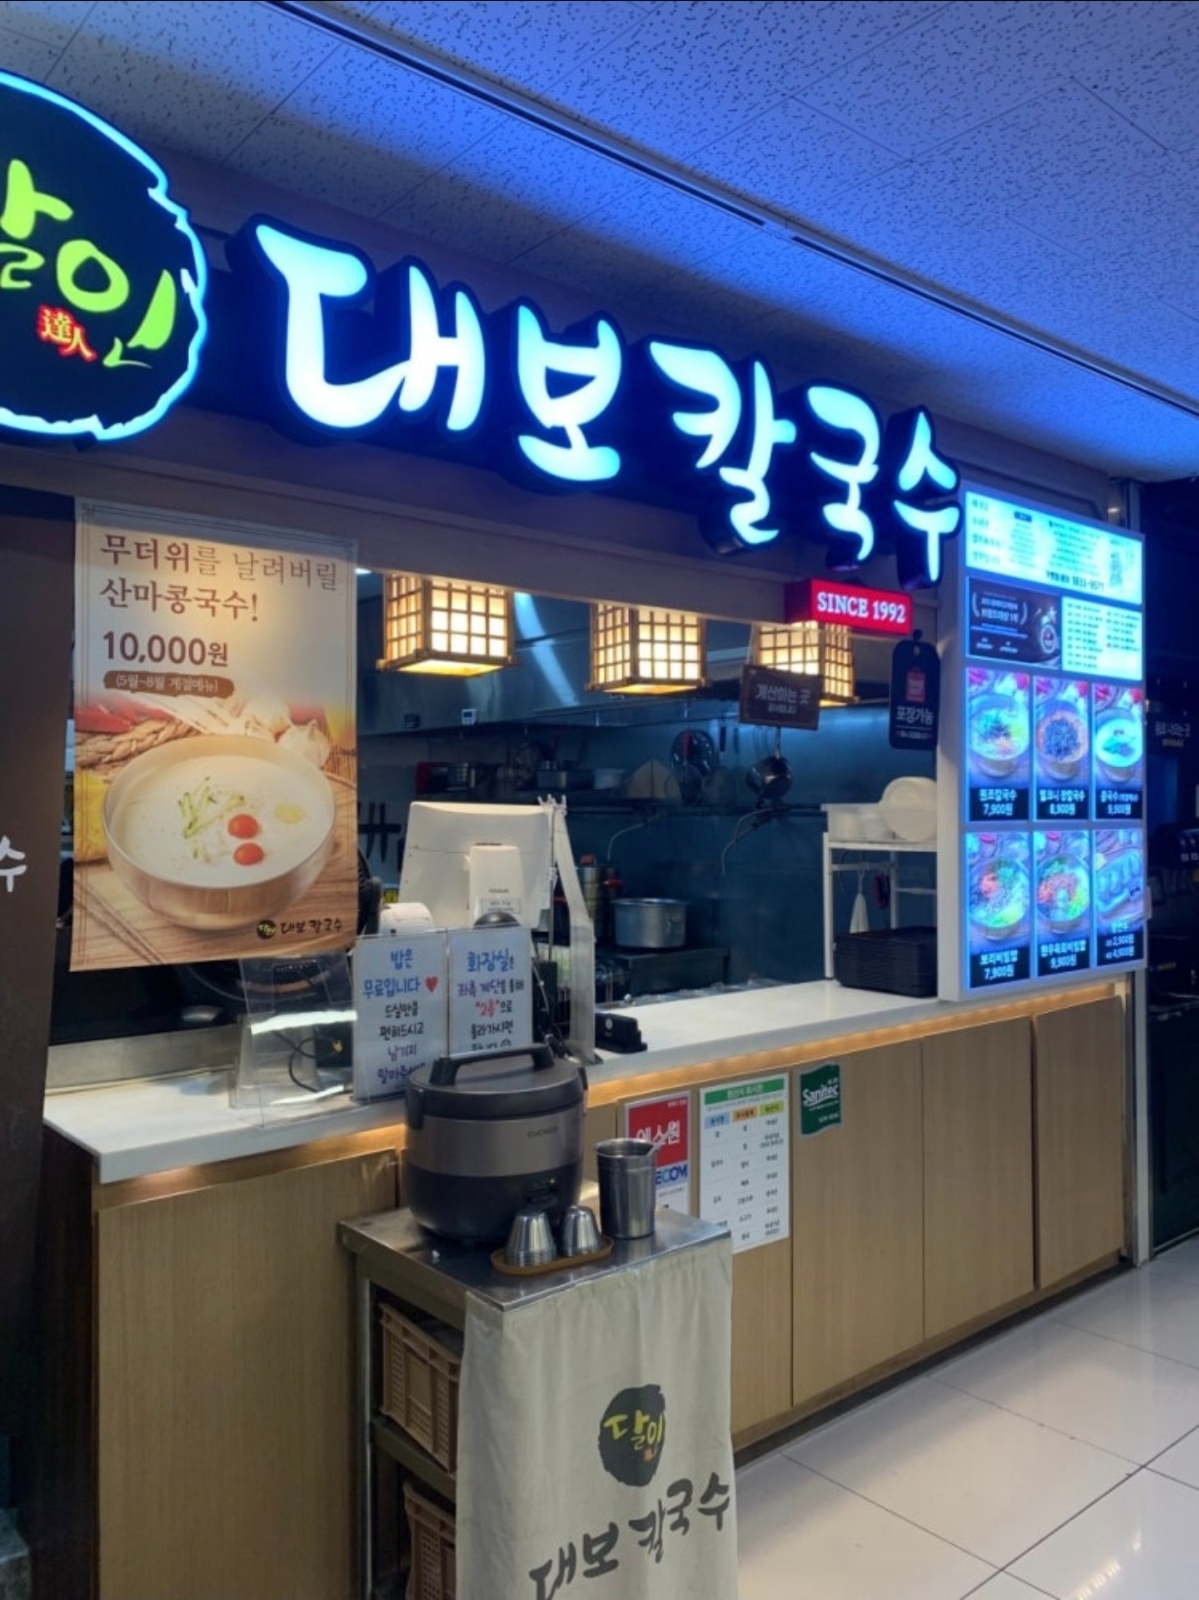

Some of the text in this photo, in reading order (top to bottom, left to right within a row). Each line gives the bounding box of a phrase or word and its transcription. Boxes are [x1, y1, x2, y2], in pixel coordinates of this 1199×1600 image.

[38, 305, 97, 361] 達人
[255, 223, 960, 582] 대보칼국수
[100, 533, 338, 592] 무더위를 날려버릴
[100, 577, 258, 622] 산마콩국수!
[817, 591, 906, 623] SINCE 1992
[103, 631, 228, 668] 10,000원
[756, 683, 810, 705] 계산하는 곳
[896, 706, 935, 726] 포장가능
[390, 949, 414, 970] 밥은
[363, 976, 422, 999] 무료입니다
[457, 982, 477, 998] 좌측
[479, 979, 507, 995] 계단을
[384, 1001, 419, 1019] 드실만큼
[470, 1020, 514, 1041] 올라가시면
[803, 1083, 839, 1102] Sanitec
[656, 1163, 689, 1185] ECOM
